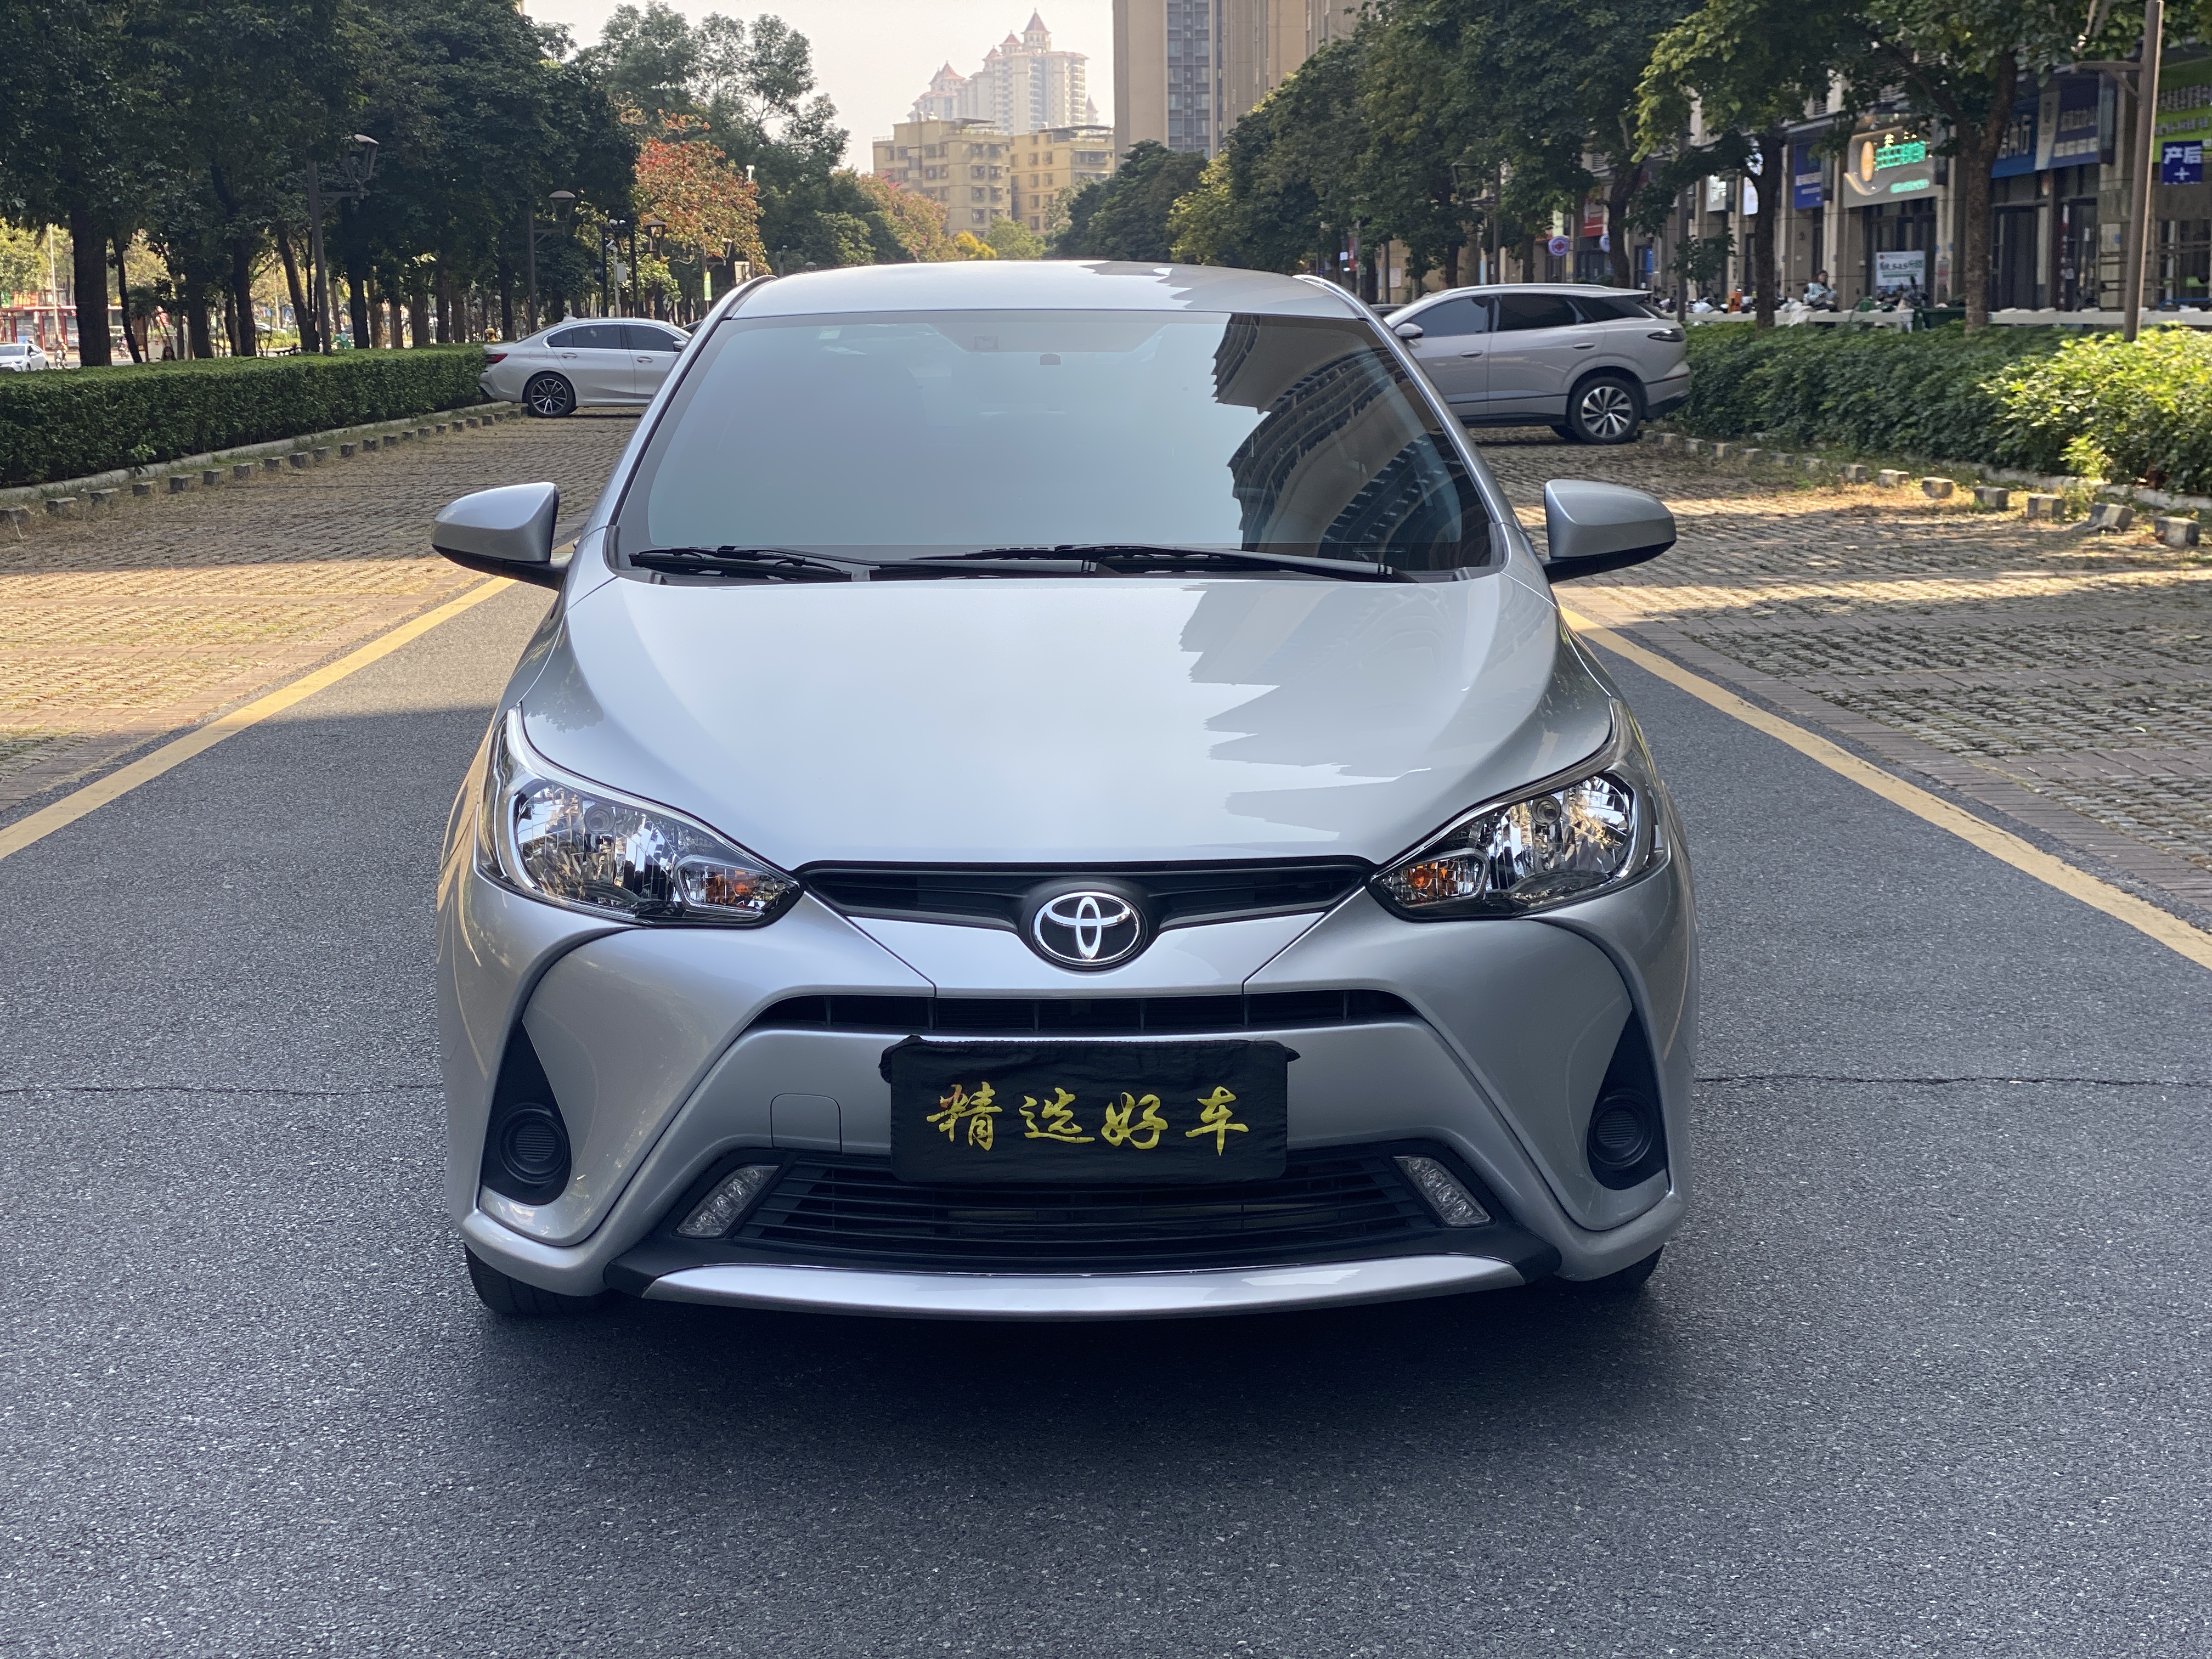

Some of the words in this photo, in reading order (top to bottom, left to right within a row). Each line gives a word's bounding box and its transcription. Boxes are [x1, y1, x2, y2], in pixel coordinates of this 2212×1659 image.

[2164, 145, 2202, 165] 产后
[926, 1081, 1249, 1156] 精选好车
